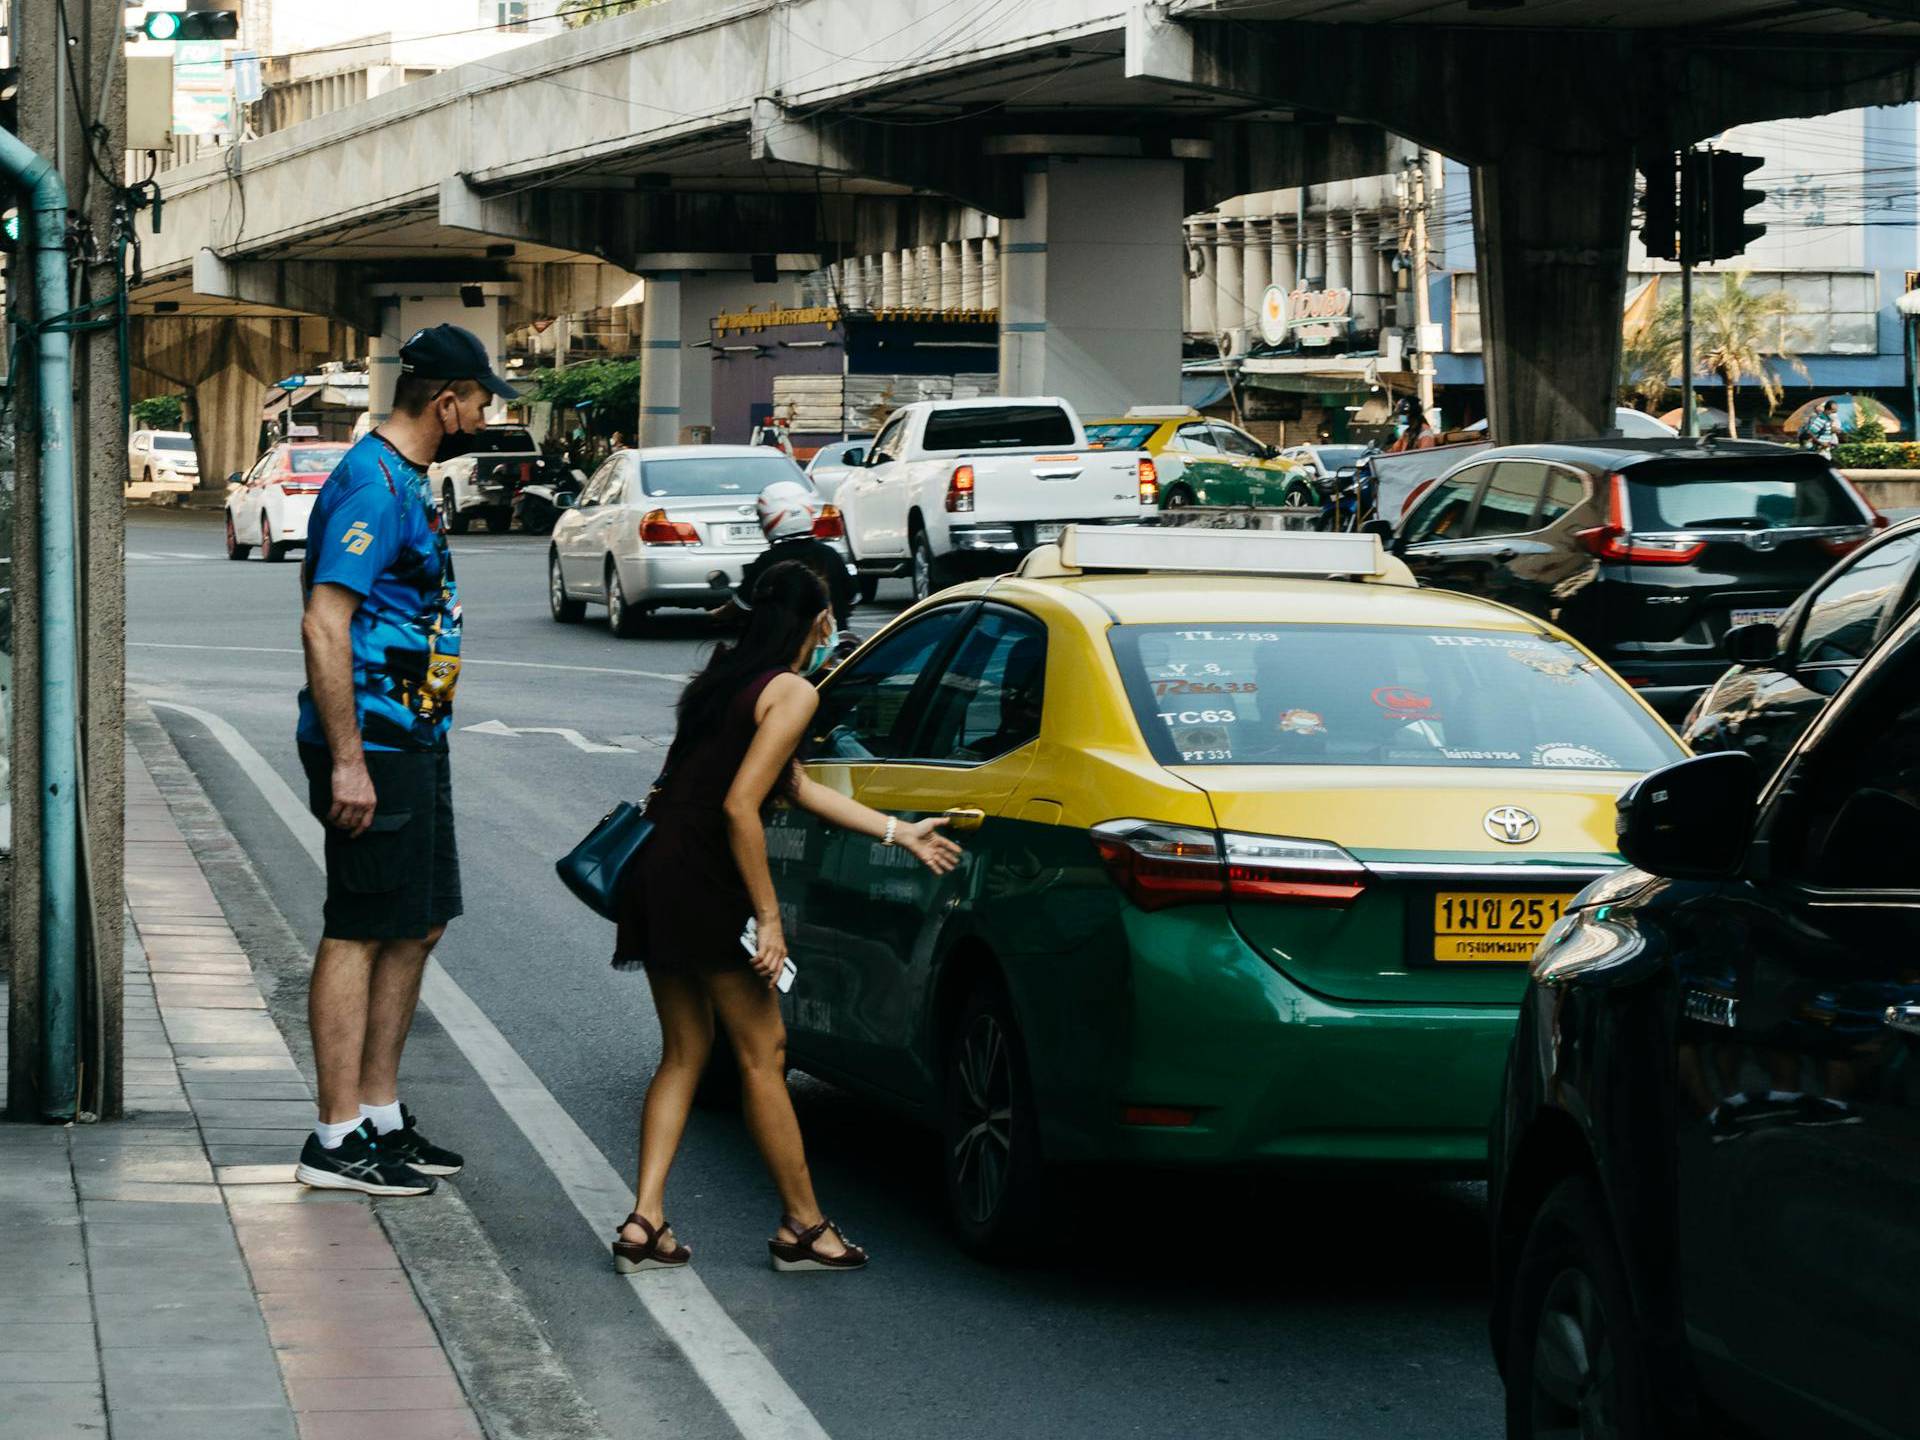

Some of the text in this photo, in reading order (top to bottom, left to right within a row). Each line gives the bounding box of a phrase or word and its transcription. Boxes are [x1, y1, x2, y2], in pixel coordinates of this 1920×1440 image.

[1157, 710, 1236, 726] TC63
[1182, 751, 1232, 761] PT 331
[1441, 898, 1502, 929] 1มข
[1455, 941, 1539, 958] กรุงเทพมหา
